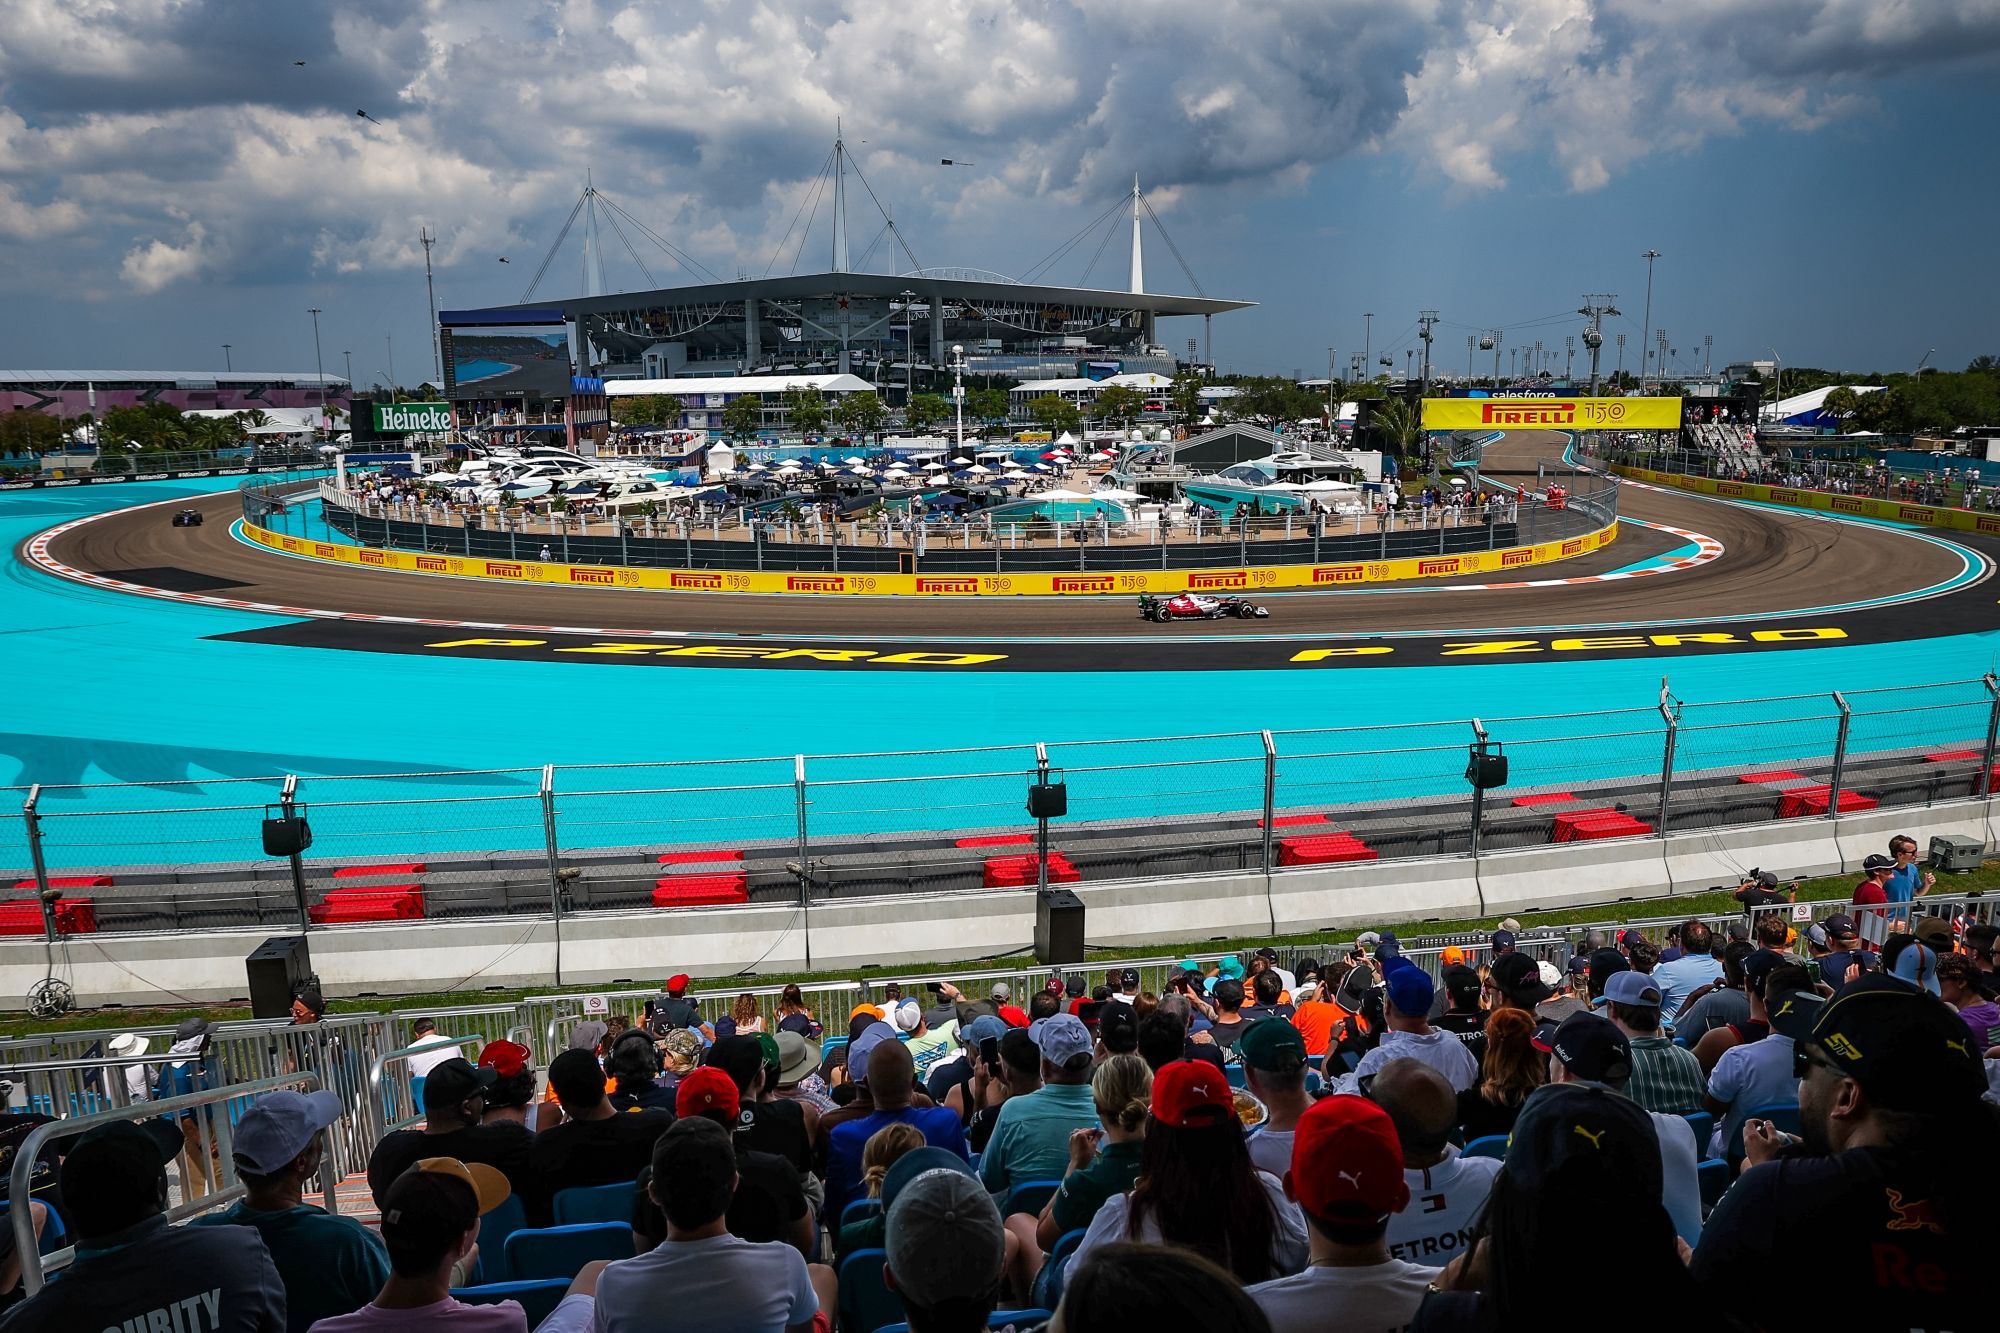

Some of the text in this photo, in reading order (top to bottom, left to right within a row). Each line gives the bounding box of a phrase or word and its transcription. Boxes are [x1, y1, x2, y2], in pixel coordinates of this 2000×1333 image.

[1492, 389, 1556, 398] salesforce
[381, 407, 451, 430] Heineke
[1482, 403, 1626, 424] PIRELLI 150
[752, 451, 777, 461] MSC
[1717, 483, 1743, 496] PIRELLI
[1770, 490, 1798, 503] PIRELLI
[1832, 497, 1862, 512] PIRELLI
[1900, 506, 1935, 522] PIRELLI
[1977, 516, 2000, 532] PIRE
[1562, 540, 1582, 555] PIRELLI
[359, 550, 384, 564] PIRELLI
[416, 557, 447, 571] PIRELLI
[1502, 550, 1533, 565] PIRELLI
[486, 563, 543, 579] PIRELLI 150
[1313, 565, 1389, 582] PIRELLI 150
[1418, 558, 1460, 574] PIRELLI
[570, 568, 639, 584] PIRELLI 150
[671, 573, 750, 589] PIRELLI 150
[787, 576, 876, 592] PIRELLI 150
[1053, 576, 1147, 592] PIRELLI 150
[1188, 571, 1277, 588] PIRELLI 150
[916, 578, 1011, 593] PIRELLI 150
[424, 638, 1009, 665] P ZERO
[1290, 628, 1848, 662] P ZERO
[1555, 1044, 1572, 1062] telcel
[1387, 1227, 1475, 1260] ETRON
[1871, 1241, 1951, 1295] Re
